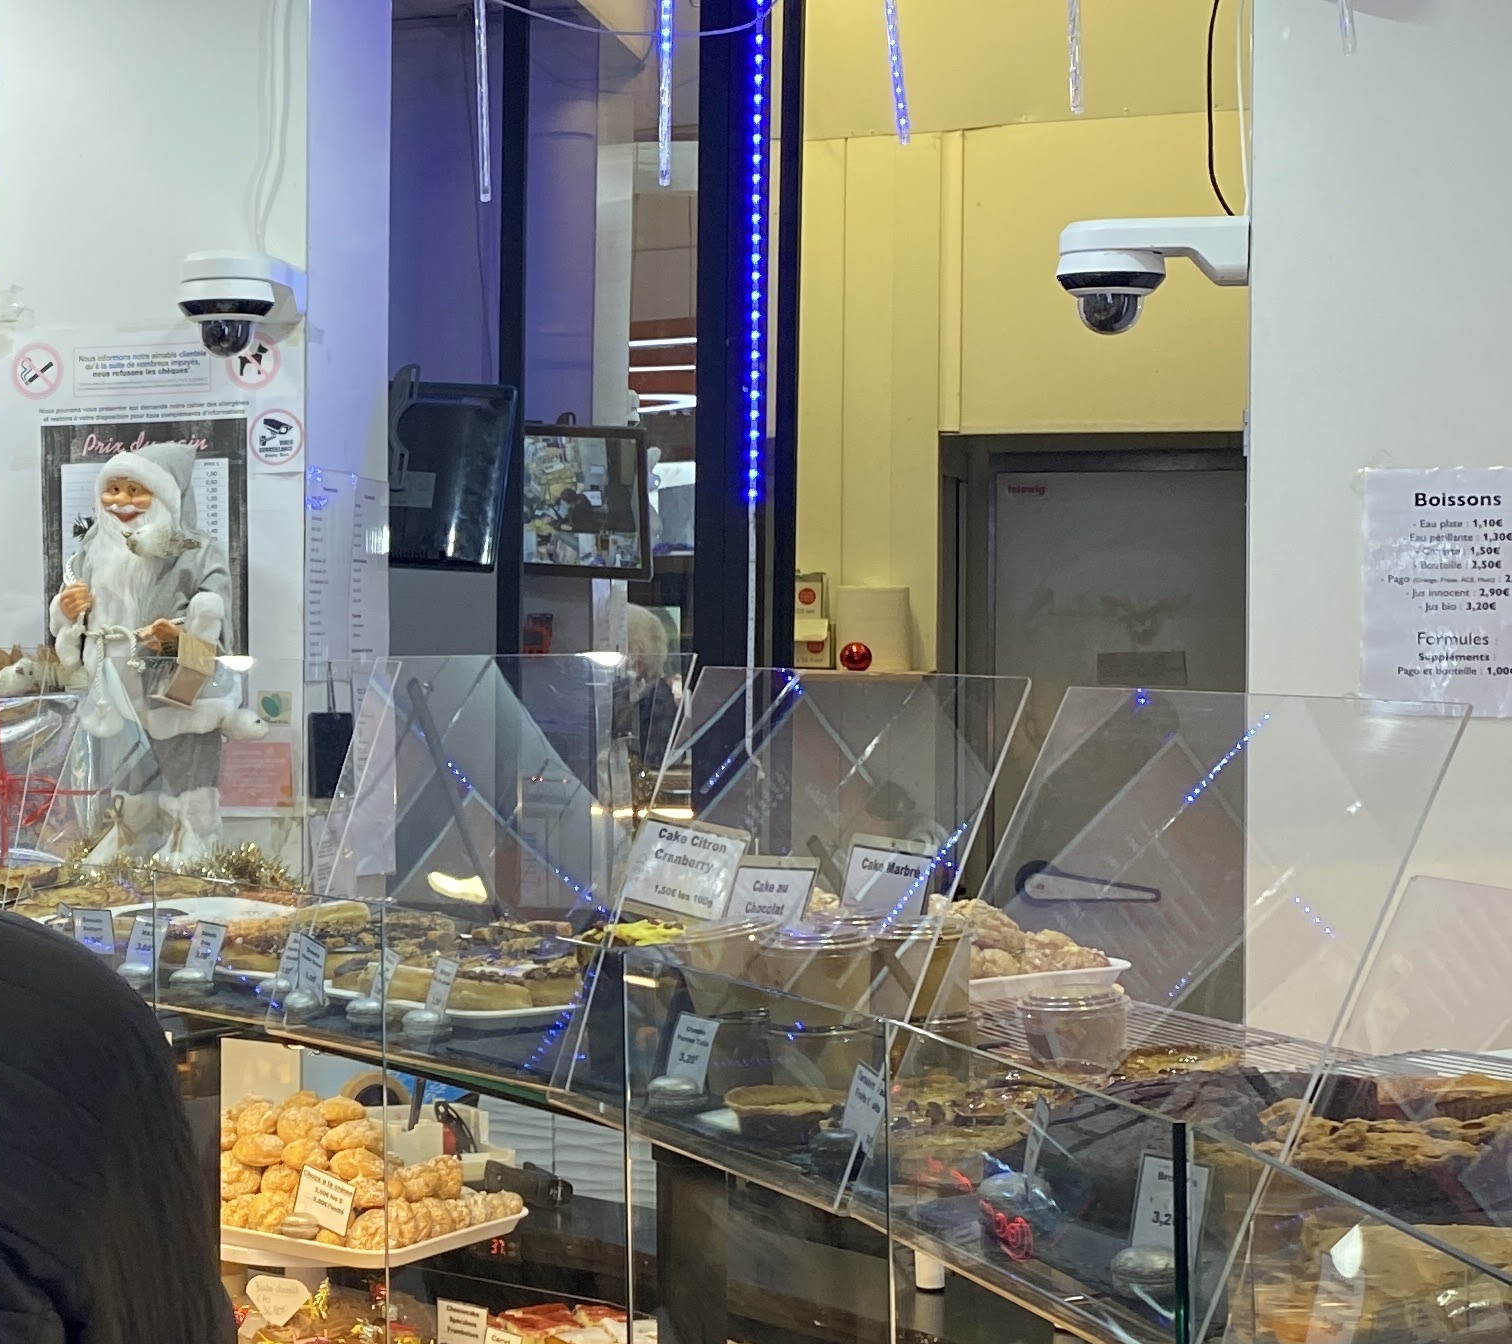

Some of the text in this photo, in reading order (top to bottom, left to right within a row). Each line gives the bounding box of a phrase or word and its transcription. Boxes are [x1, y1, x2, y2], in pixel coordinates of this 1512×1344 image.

[82, 433, 126, 457] Prix
[1414, 493, 1502, 506] Boissons
[1420, 520, 1437, 528] Eau
[1473, 519, 1503, 528] 1,10€
[1470, 547, 1500, 556] 1,50€
[1472, 560, 1502, 570] 2,50€
[1388, 575, 1410, 585] Pago
[1412, 588, 1425, 599] Jus
[1480, 588, 1510, 598] 2,90€
[1425, 602, 1439, 612] Jus
[1466, 602, 1496, 611] 3,20€
[1417, 632, 1489, 645] Formules
[1398, 667, 1420, 677] Pago
[658, 827, 728, 854] Cake Citron
[654, 848, 715, 875] Cranberry
[752, 880, 775, 894] Cake
[744, 901, 785, 916] Chocolat
